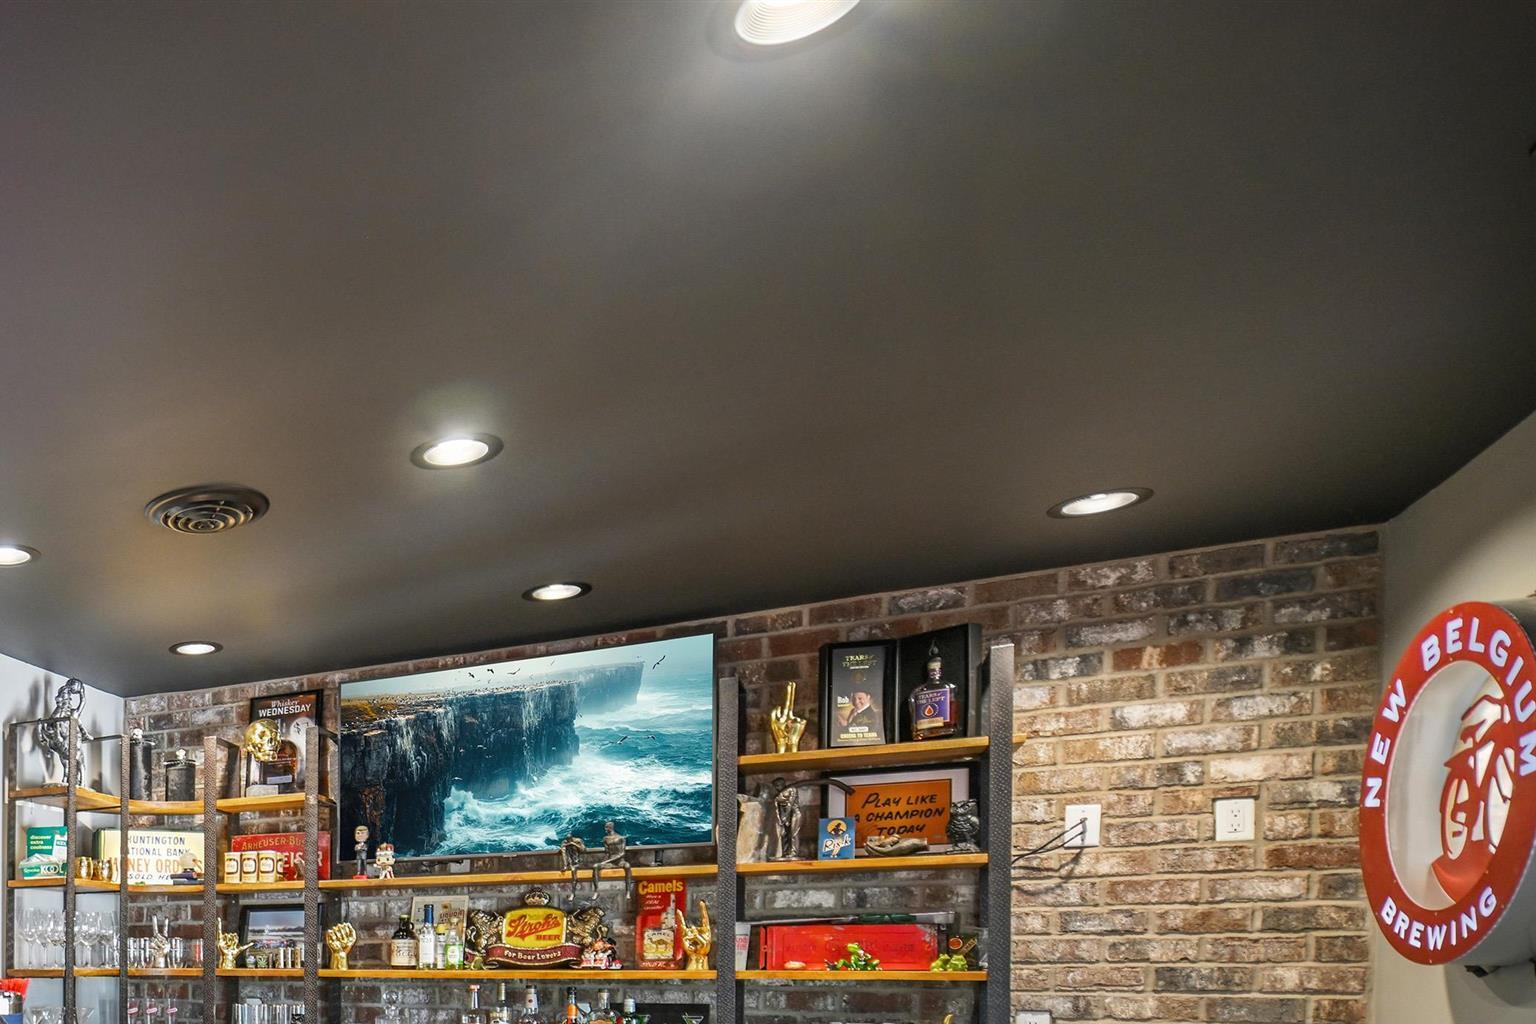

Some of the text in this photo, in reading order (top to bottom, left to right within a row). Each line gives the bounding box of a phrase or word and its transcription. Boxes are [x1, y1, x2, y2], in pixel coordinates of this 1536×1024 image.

[271, 699, 300, 707] Whiskey
[259, 704, 311, 717] WEDNESDAY
[1365, 617, 1536, 807] NEW BELGIUM
[862, 792, 937, 808] PLAY LIKE
[866, 807, 945, 822] CHAMPION
[877, 824, 926, 836] TODAY
[242, 836, 305, 850] ANHEUSER-BUS
[129, 847, 161, 856] TIONAL
[40, 865, 64, 875] KOOL
[128, 858, 181, 873] NEY ORD
[638, 880, 683, 895] Camels
[1380, 887, 1497, 951] BREWING
[507, 914, 562, 939] Stroh's
[517, 952, 535, 960] Beer
[537, 951, 561, 960] Lovers
